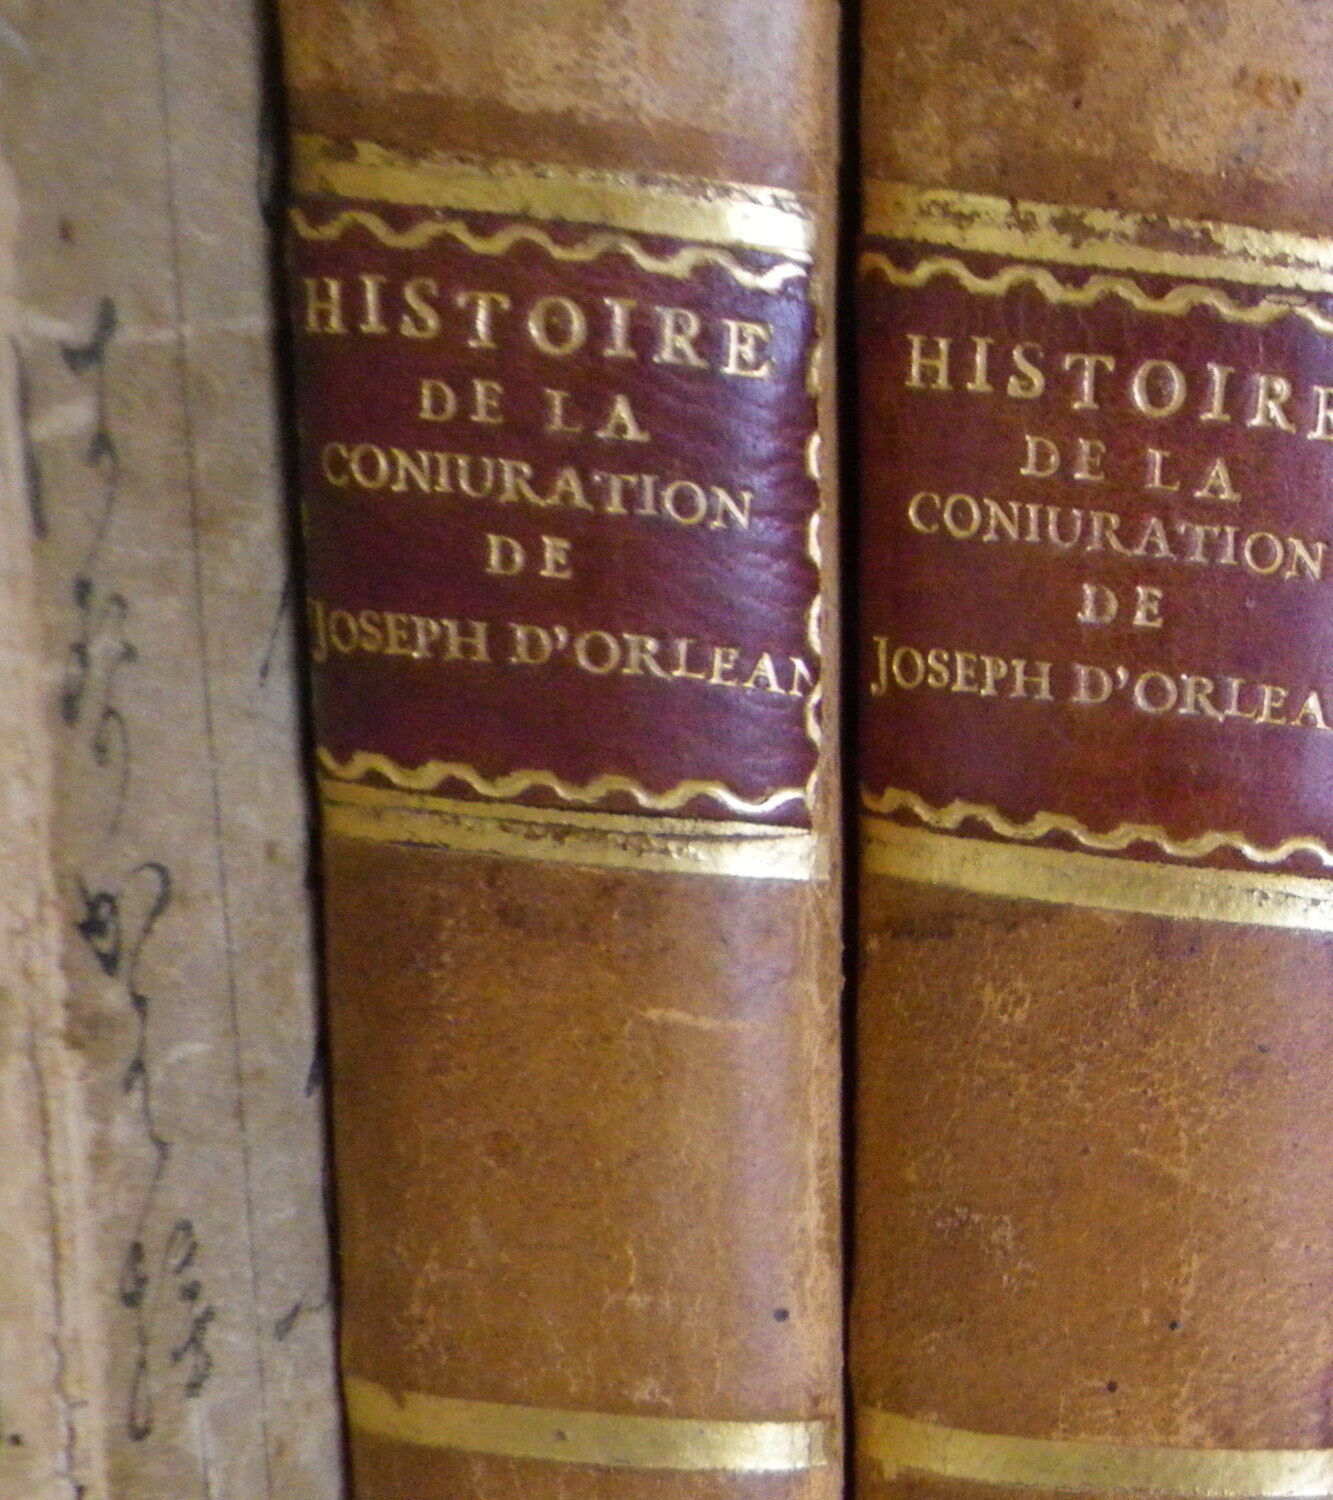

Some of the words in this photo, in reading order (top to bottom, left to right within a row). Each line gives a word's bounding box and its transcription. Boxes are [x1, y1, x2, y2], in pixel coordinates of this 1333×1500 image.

[305, 273, 775, 378] HISTOIRE
[419, 378, 505, 424] DE
[544, 388, 650, 442] LA
[321, 441, 754, 532] CONIURATION
[1020, 434, 1107, 482] DE
[1145, 447, 1242, 502] LA
[486, 533, 573, 579] DE
[907, 491, 1328, 581] CONIURATION
[309, 599, 493, 663] JOSEPH
[1077, 582, 1164, 629] DE
[870, 635, 1055, 701] JOSEPH
